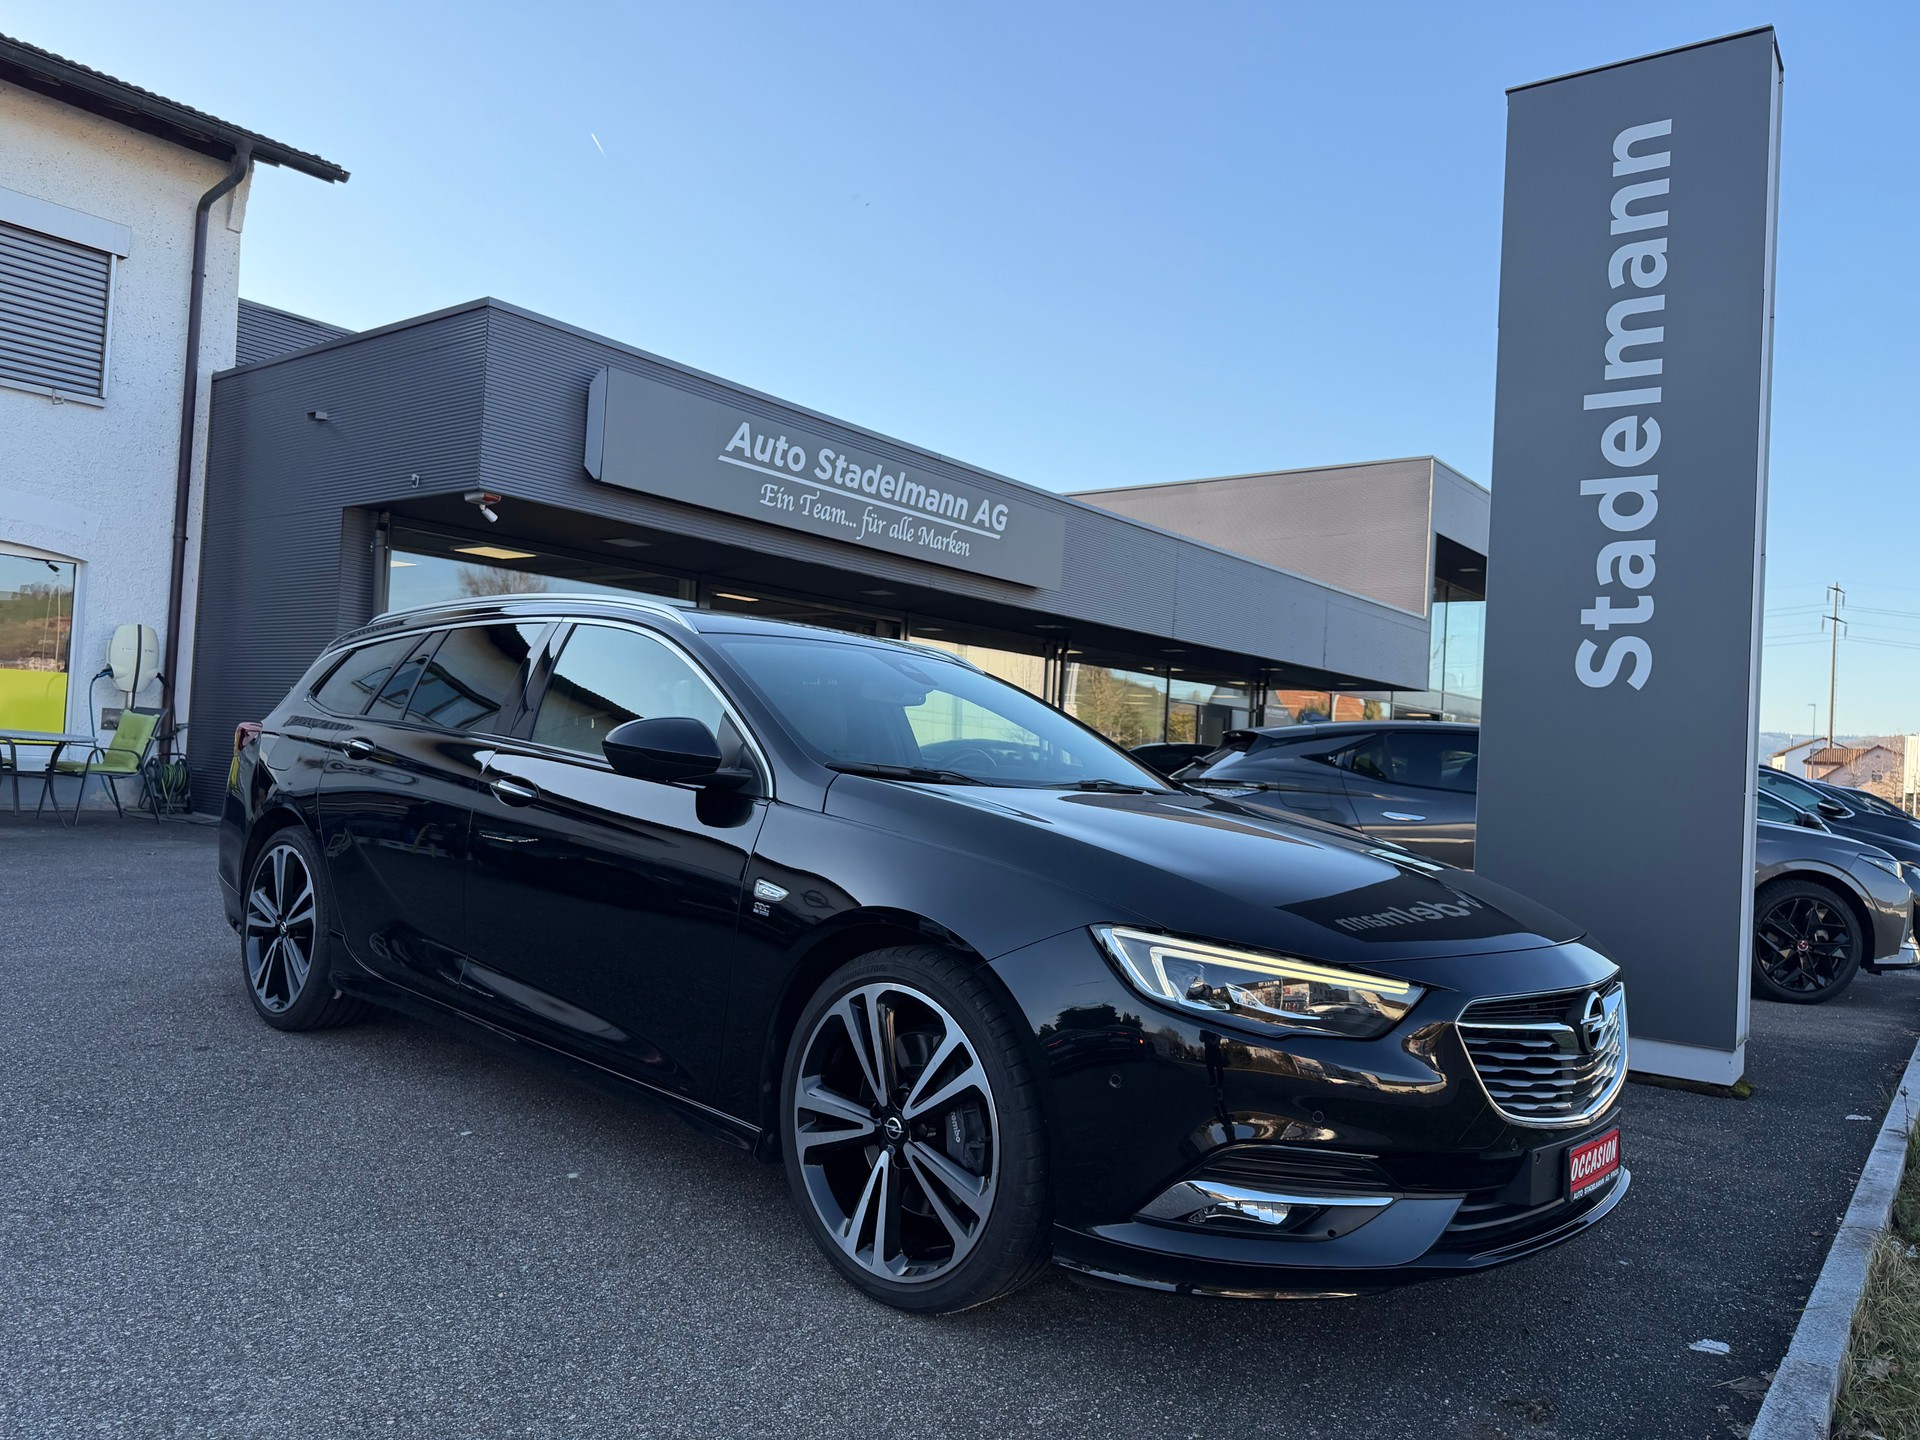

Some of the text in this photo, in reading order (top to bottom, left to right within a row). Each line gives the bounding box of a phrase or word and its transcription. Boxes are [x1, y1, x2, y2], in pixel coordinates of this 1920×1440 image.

[1575, 118, 1672, 691] Stadelmann
[724, 421, 1010, 532] Auto Stadelmann AG
[759, 483, 971, 557] Ein Team... für alle Marken
[1571, 1136, 1618, 1182] OCCASION
